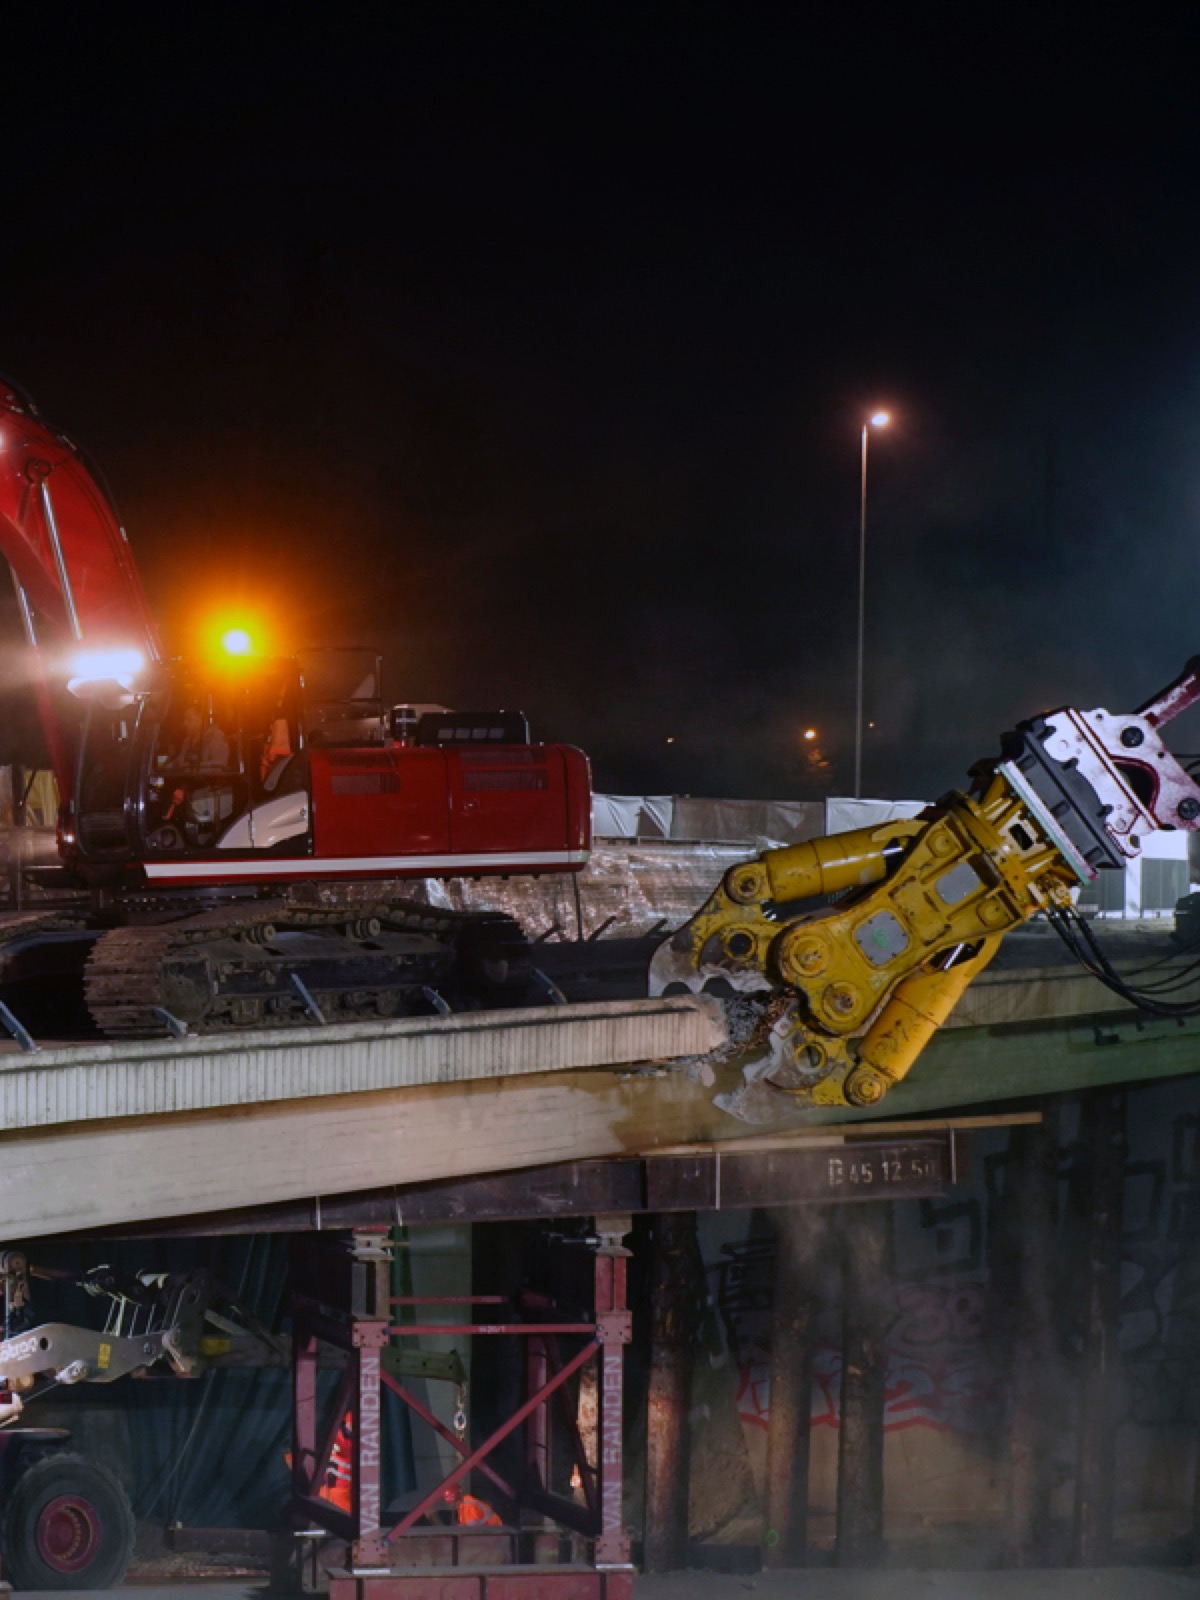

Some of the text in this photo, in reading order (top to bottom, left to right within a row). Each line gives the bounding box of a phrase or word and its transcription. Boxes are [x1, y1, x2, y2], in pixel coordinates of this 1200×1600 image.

[360, 1357, 380, 1536] VAN RANDEN
[603, 1481, 622, 1531] VAN
